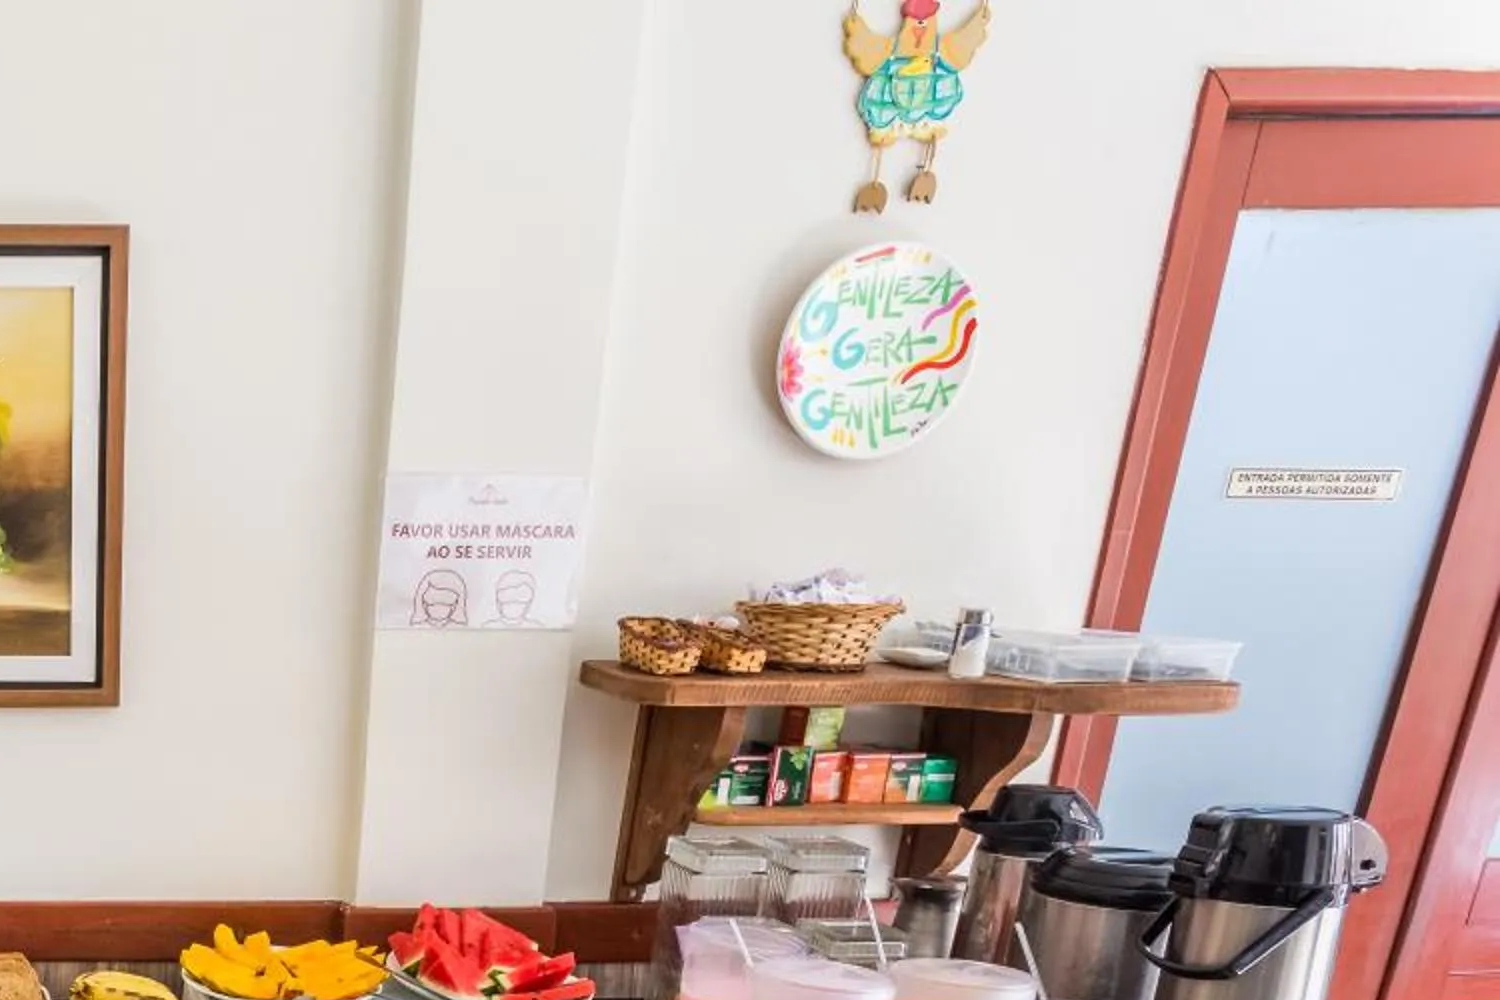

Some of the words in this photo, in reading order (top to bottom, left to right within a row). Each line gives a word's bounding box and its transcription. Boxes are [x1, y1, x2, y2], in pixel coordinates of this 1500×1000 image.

[801, 257, 965, 342] GENTILEZA
[831, 327, 938, 371] GERA
[801, 377, 959, 450] GENTILEZA
[1237, 472, 1285, 483] ENTRADA
[1286, 473, 1341, 483] PERMITIDA
[1343, 473, 1393, 484] SOMENTE
[1246, 485, 1253, 494] A
[1255, 485, 1303, 495] PESSOAS
[1305, 485, 1378, 496] AUTORIZADAS
[391, 523, 443, 539] FAVOR
[449, 524, 491, 539] USAR
[426, 545, 450, 559] AO
[455, 545, 473, 559] SE
[477, 545, 532, 559] SERVIR
